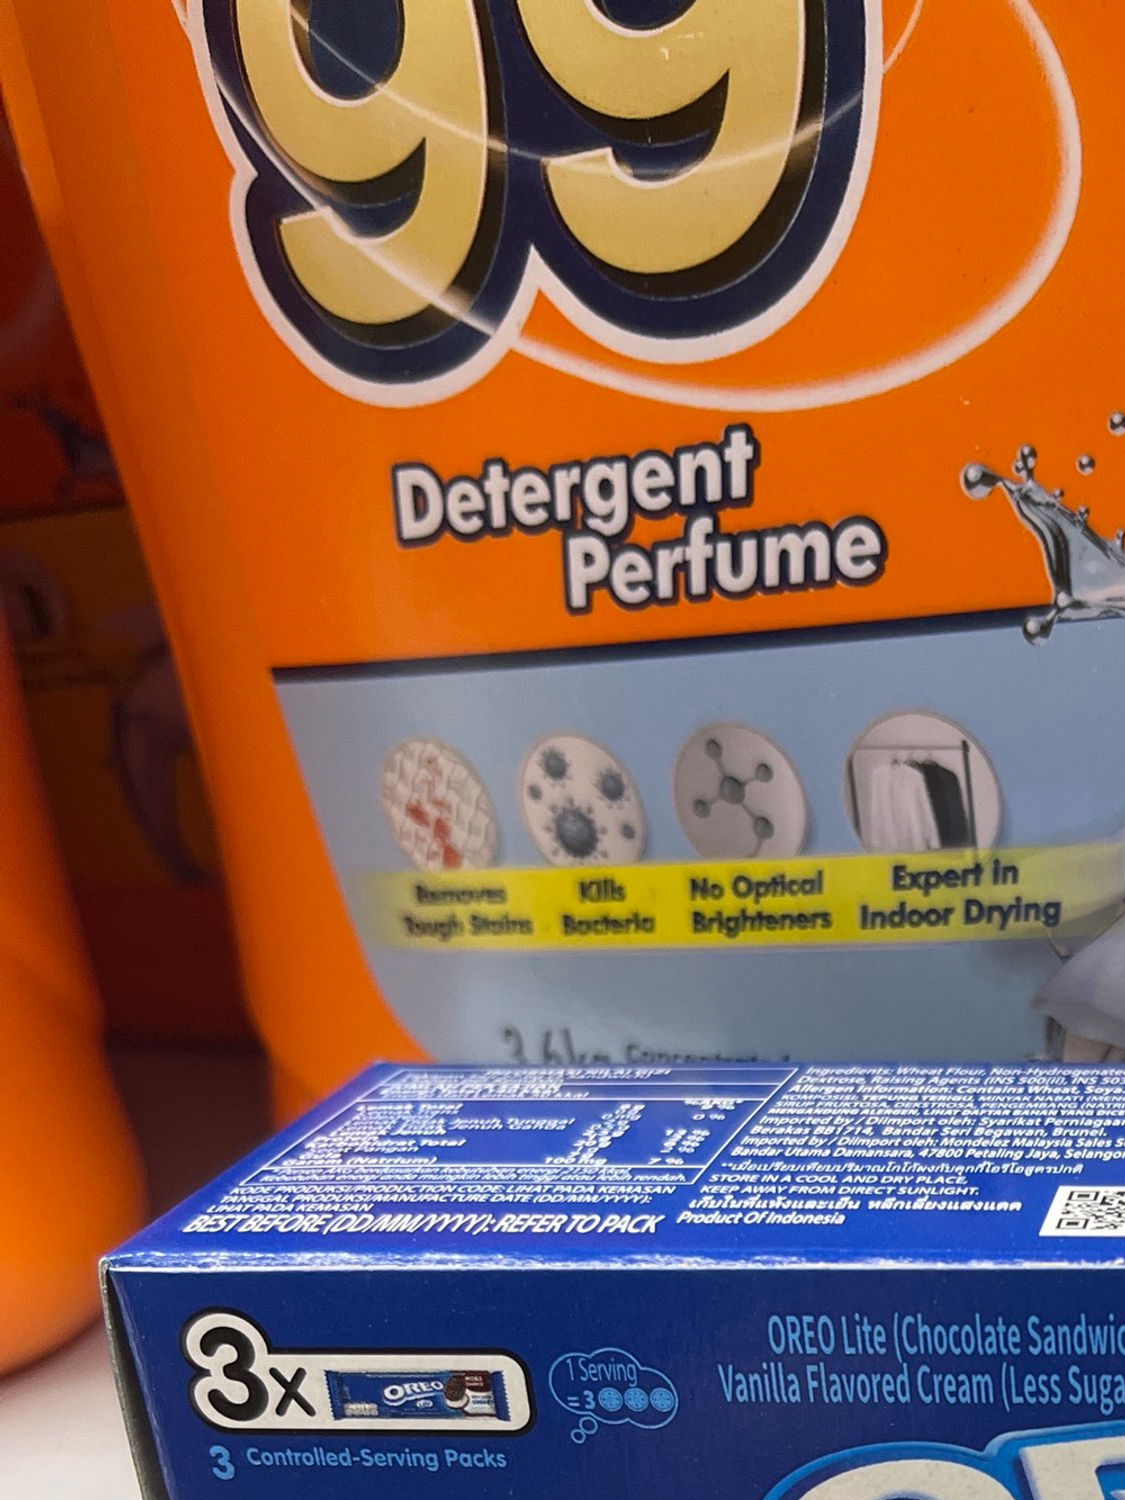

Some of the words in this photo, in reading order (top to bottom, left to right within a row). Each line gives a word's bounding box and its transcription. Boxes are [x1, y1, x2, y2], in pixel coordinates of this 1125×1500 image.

[393, 426, 757, 545] Detergent
[564, 519, 885, 610] Perfume
[578, 877, 626, 903] Kills
[690, 877, 725, 901] No
[730, 869, 825, 904] Optical
[891, 862, 983, 897] Expert
[562, 912, 656, 936] Bacteria
[692, 906, 834, 940] Brighteners
[860, 898, 955, 930] Indoor
[963, 895, 1062, 932] Drying
[881, 1126, 938, 1136] Bandar
[730, 1146, 783, 1157] Bandar
[784, 1147, 831, 1158] Utama
[832, 1147, 915, 1159] Damansara,
[918, 1148, 963, 1159] 47800
[965, 1147, 1024, 1161] Petaling
[229, 1184, 273, 1194] KODE
[507, 1185, 556, 1194] LIHAT
[556, 1185, 596, 1194] PADA
[597, 1185, 677, 1195] KEMASAN
[699, 1185, 739, 1194] KEEP
[740, 1185, 787, 1194] AWAY
[787, 1186, 836, 1195] FROM
[837, 1186, 896, 1195] DIRECT
[896, 1187, 980, 1196] SUNLIGHT.
[709, 1174, 760, 1183] STORE
[761, 1174, 779, 1183] IN
[779, 1175, 792, 1183] A
[795, 1175, 838, 1184] COOL
[841, 1175, 879, 1184] AND
[880, 1176, 913, 1184] DRY
[915, 1176, 969, 1185] PLACE,
[295, 1203, 374, 1213] KEMASAN
[676, 1210, 743, 1224] Product
[743, 1211, 768, 1224] Of
[766, 1211, 846, 1225] Indonesia
[182, 1214, 250, 1233] BEST
[237, 1214, 334, 1233] BEFORE
[492, 1214, 571, 1234] REFER
[567, 1214, 602, 1234] TO
[597, 1214, 666, 1234] PACK
[767, 1314, 836, 1356] OREO
[841, 1313, 887, 1356] Lite
[893, 1313, 1022, 1361] (Chocolate
[566, 1358, 575, 1382] 1
[578, 1357, 638, 1387] Serving
[383, 1379, 444, 1402] OREO
[717, 1364, 801, 1404] Vanilla
[806, 1363, 911, 1404] Flavored
[917, 1365, 996, 1404] Cream
[1001, 1364, 1064, 1412] (Less
[208, 1445, 236, 1480] 3
[246, 1447, 438, 1472] Controlled-Serving
[443, 1448, 507, 1469] Packs
